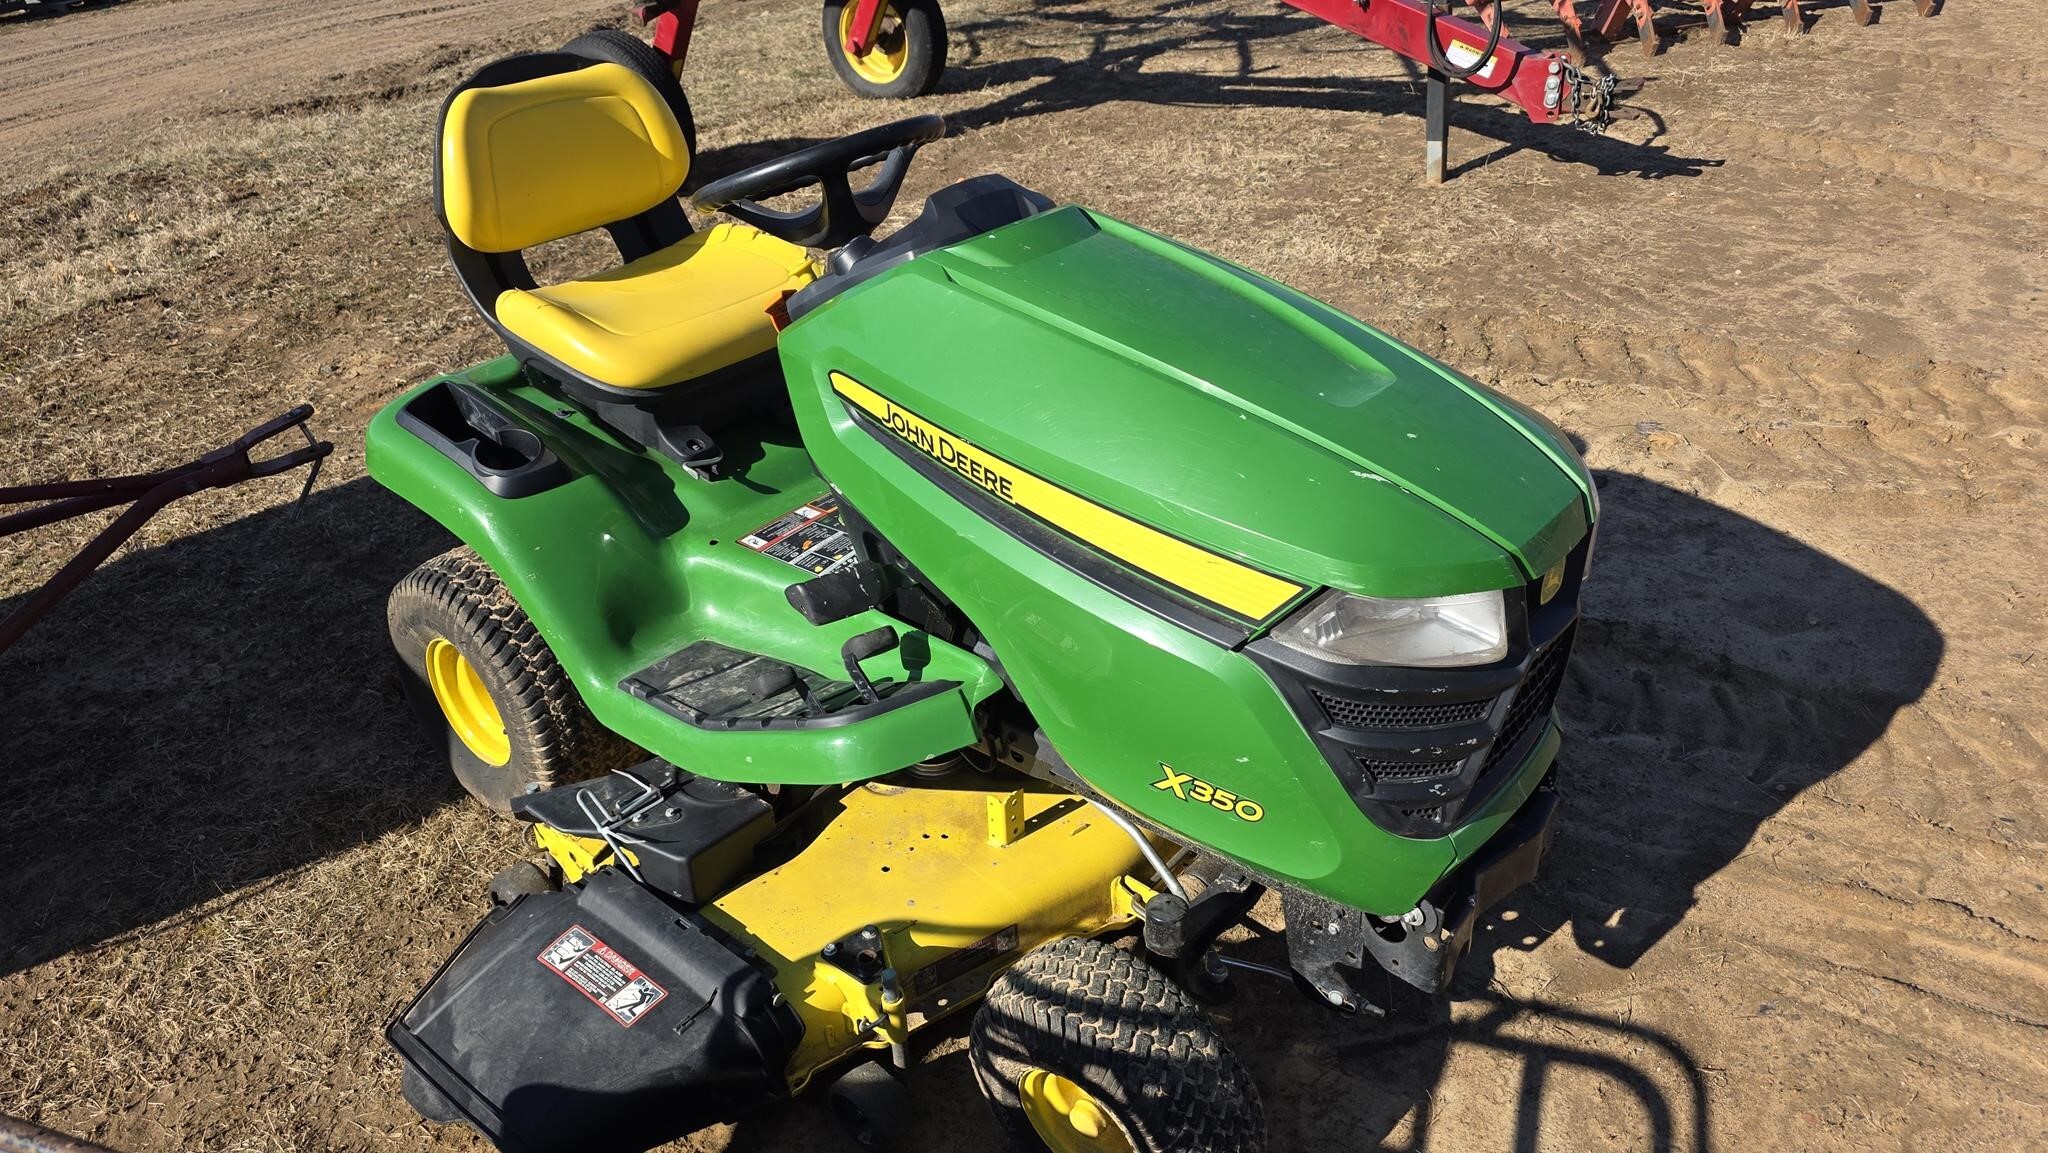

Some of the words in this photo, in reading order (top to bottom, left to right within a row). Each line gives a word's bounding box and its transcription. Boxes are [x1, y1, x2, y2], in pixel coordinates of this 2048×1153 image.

[881, 403, 935, 453] JOHN
[938, 436, 1014, 500] DEERE
[1149, 761, 1265, 822] X350
[602, 949, 636, 976] DANGER
